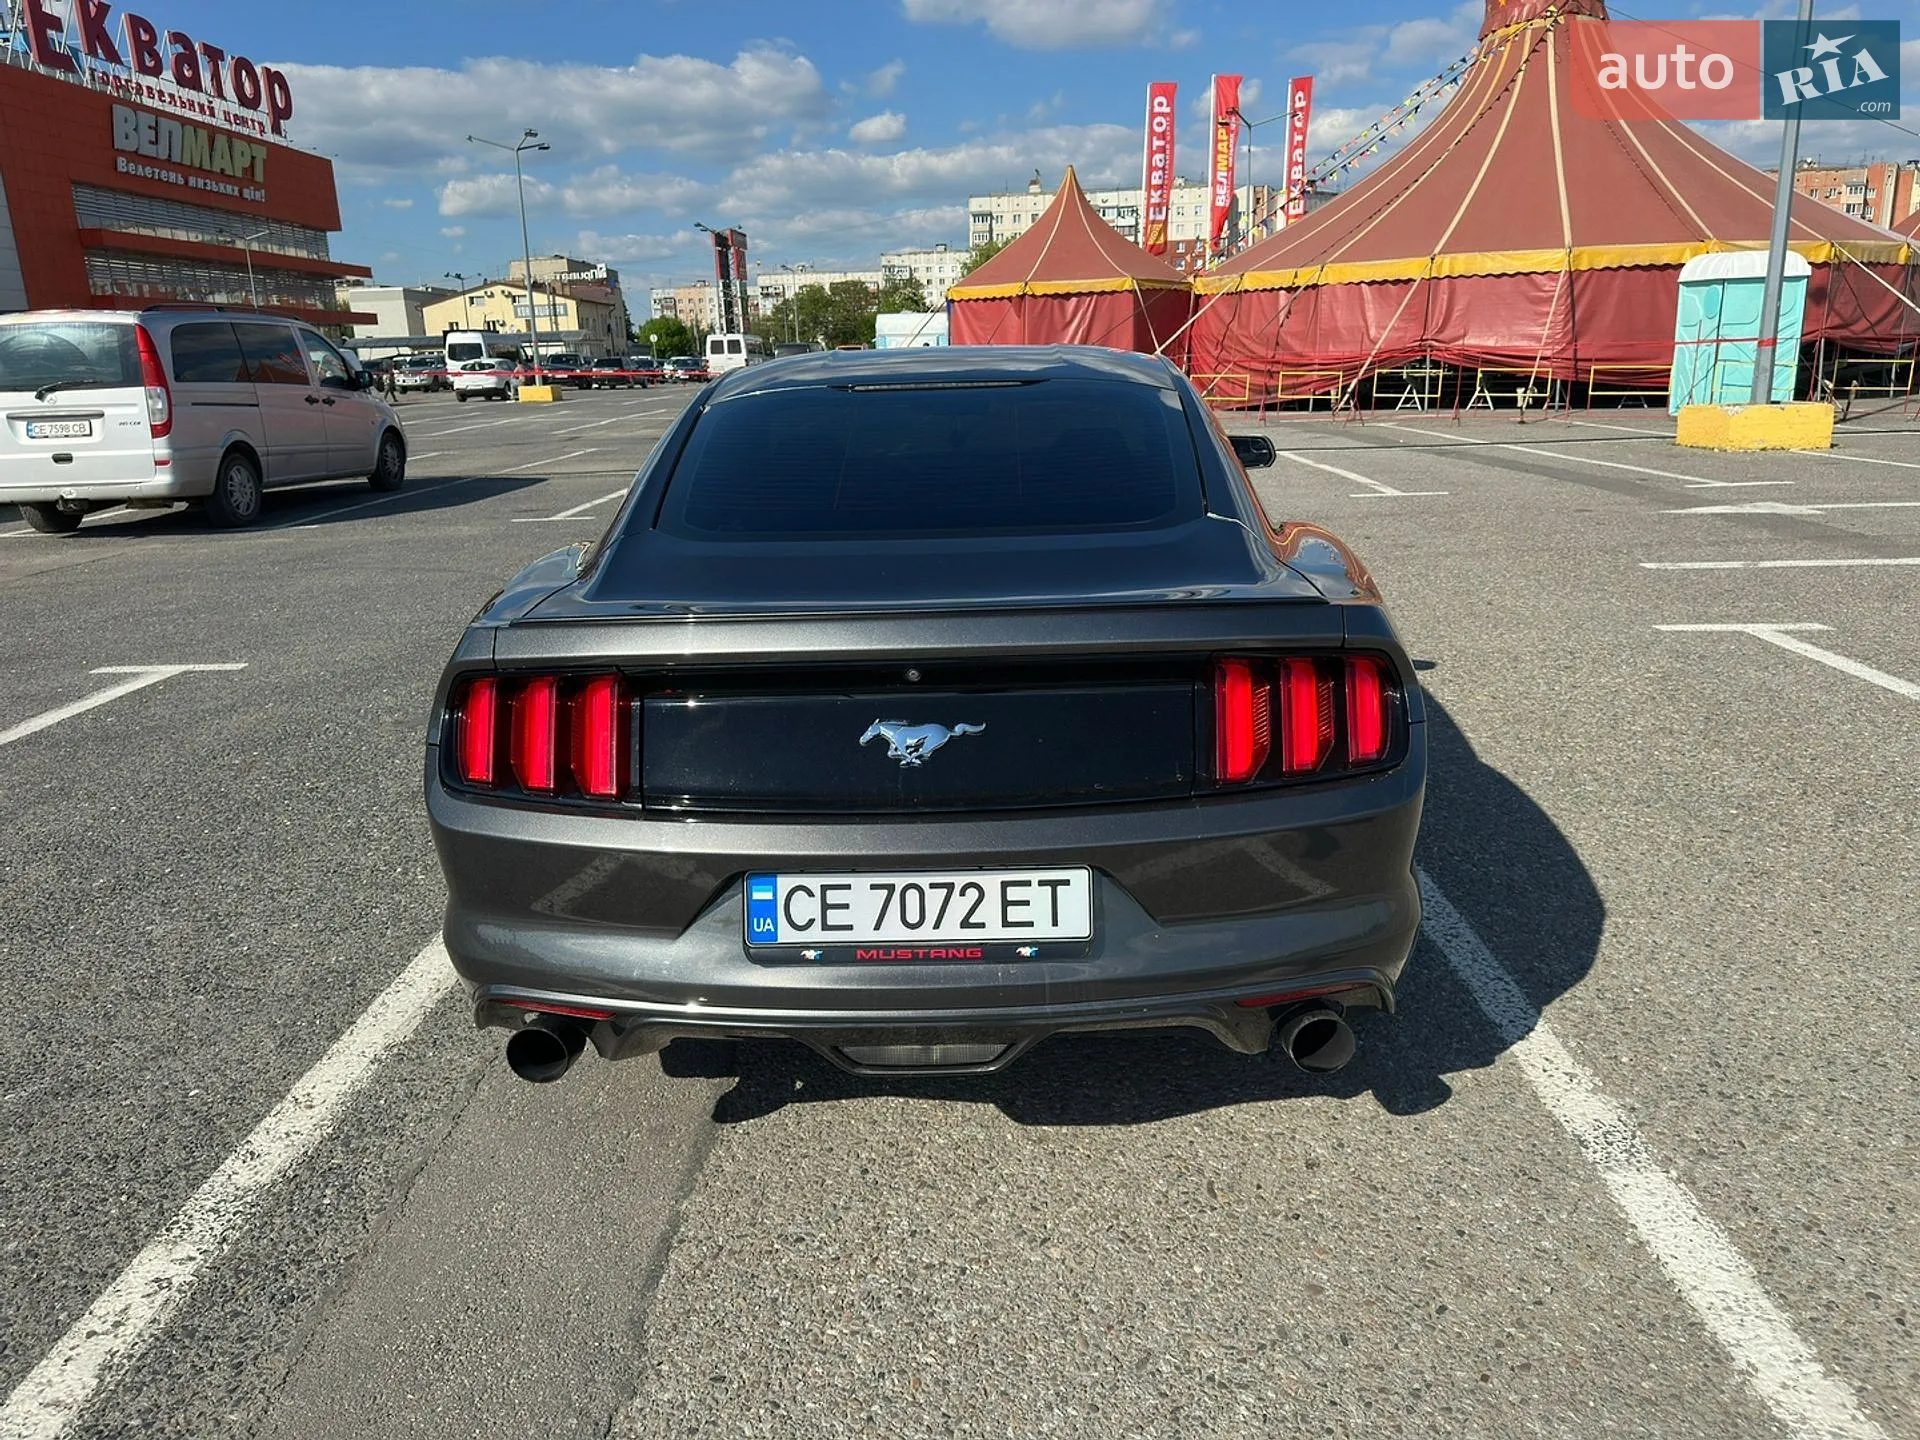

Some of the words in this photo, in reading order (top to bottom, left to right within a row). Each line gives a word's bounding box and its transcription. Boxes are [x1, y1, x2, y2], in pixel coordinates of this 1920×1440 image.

[111, 103, 267, 184] ВЕЛМАРТ
[1149, 95, 1171, 221] Екватор
[116, 156, 185, 186] Велетень
[187, 175, 239, 198] низьких
[33, 424, 47, 435] CE
[48, 423, 71, 434] 7598
[752, 917, 775, 933] UA
[783, 883, 854, 932] CE
[868, 881, 987, 932] 7072
[1000, 878, 1072, 929] ET
[855, 947, 983, 961] MUSTANG
